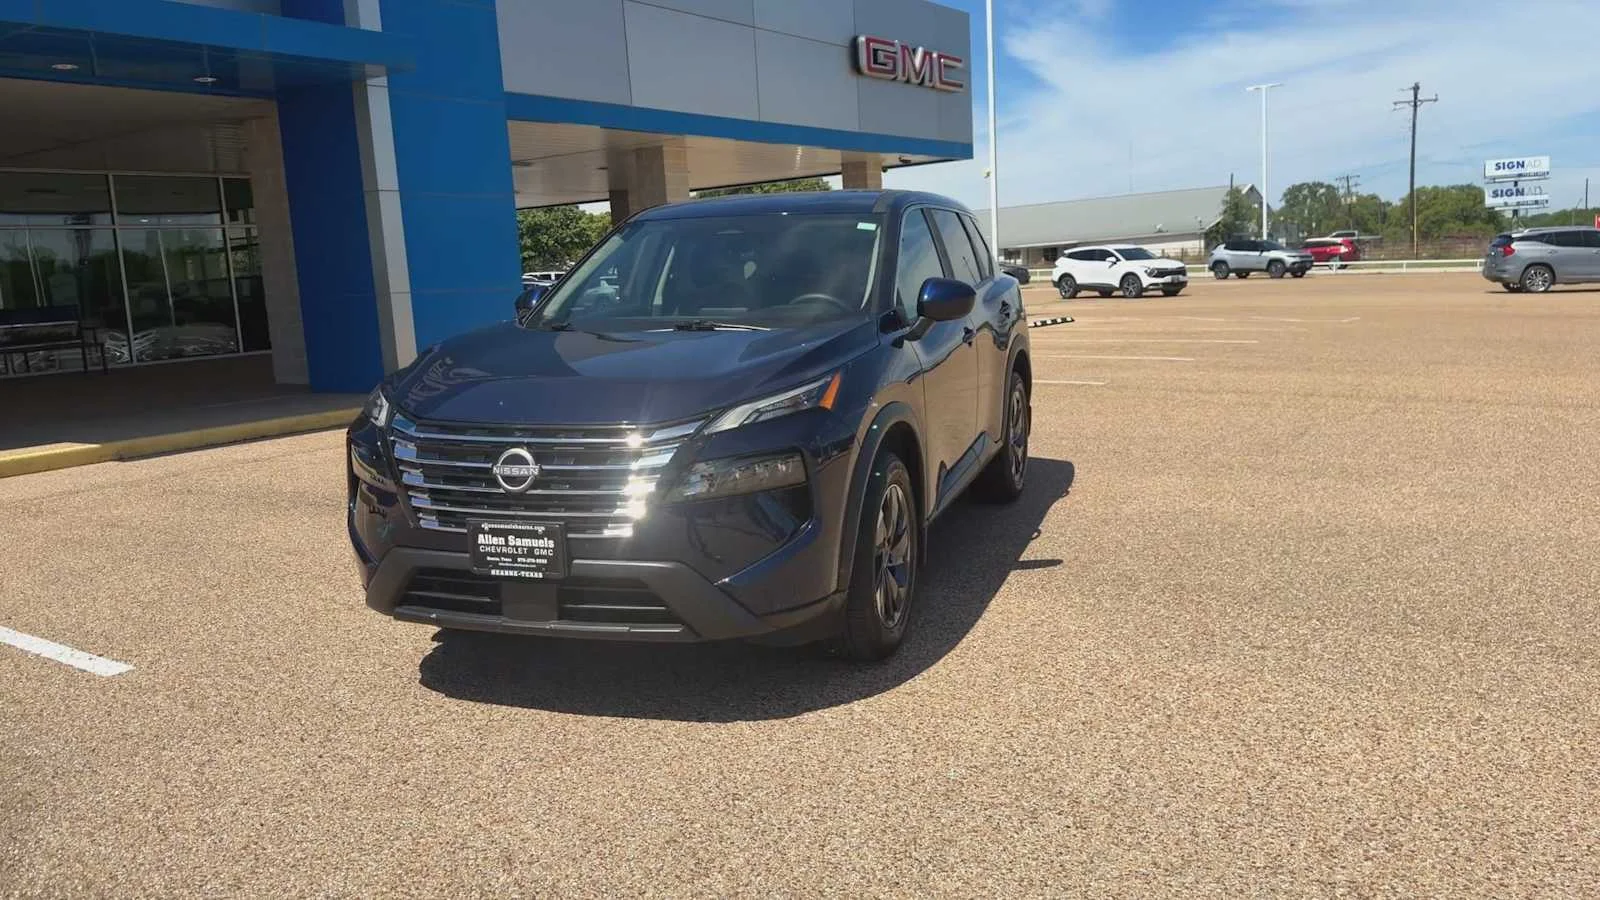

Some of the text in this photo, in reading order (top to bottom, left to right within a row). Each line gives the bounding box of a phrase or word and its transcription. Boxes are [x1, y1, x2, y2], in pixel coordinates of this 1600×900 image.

[857, 35, 965, 92] GMC
[493, 465, 539, 475] NISSAN
[477, 533, 555, 548] Allen Samuels
[479, 545, 554, 556] CHEVROLET GMC
